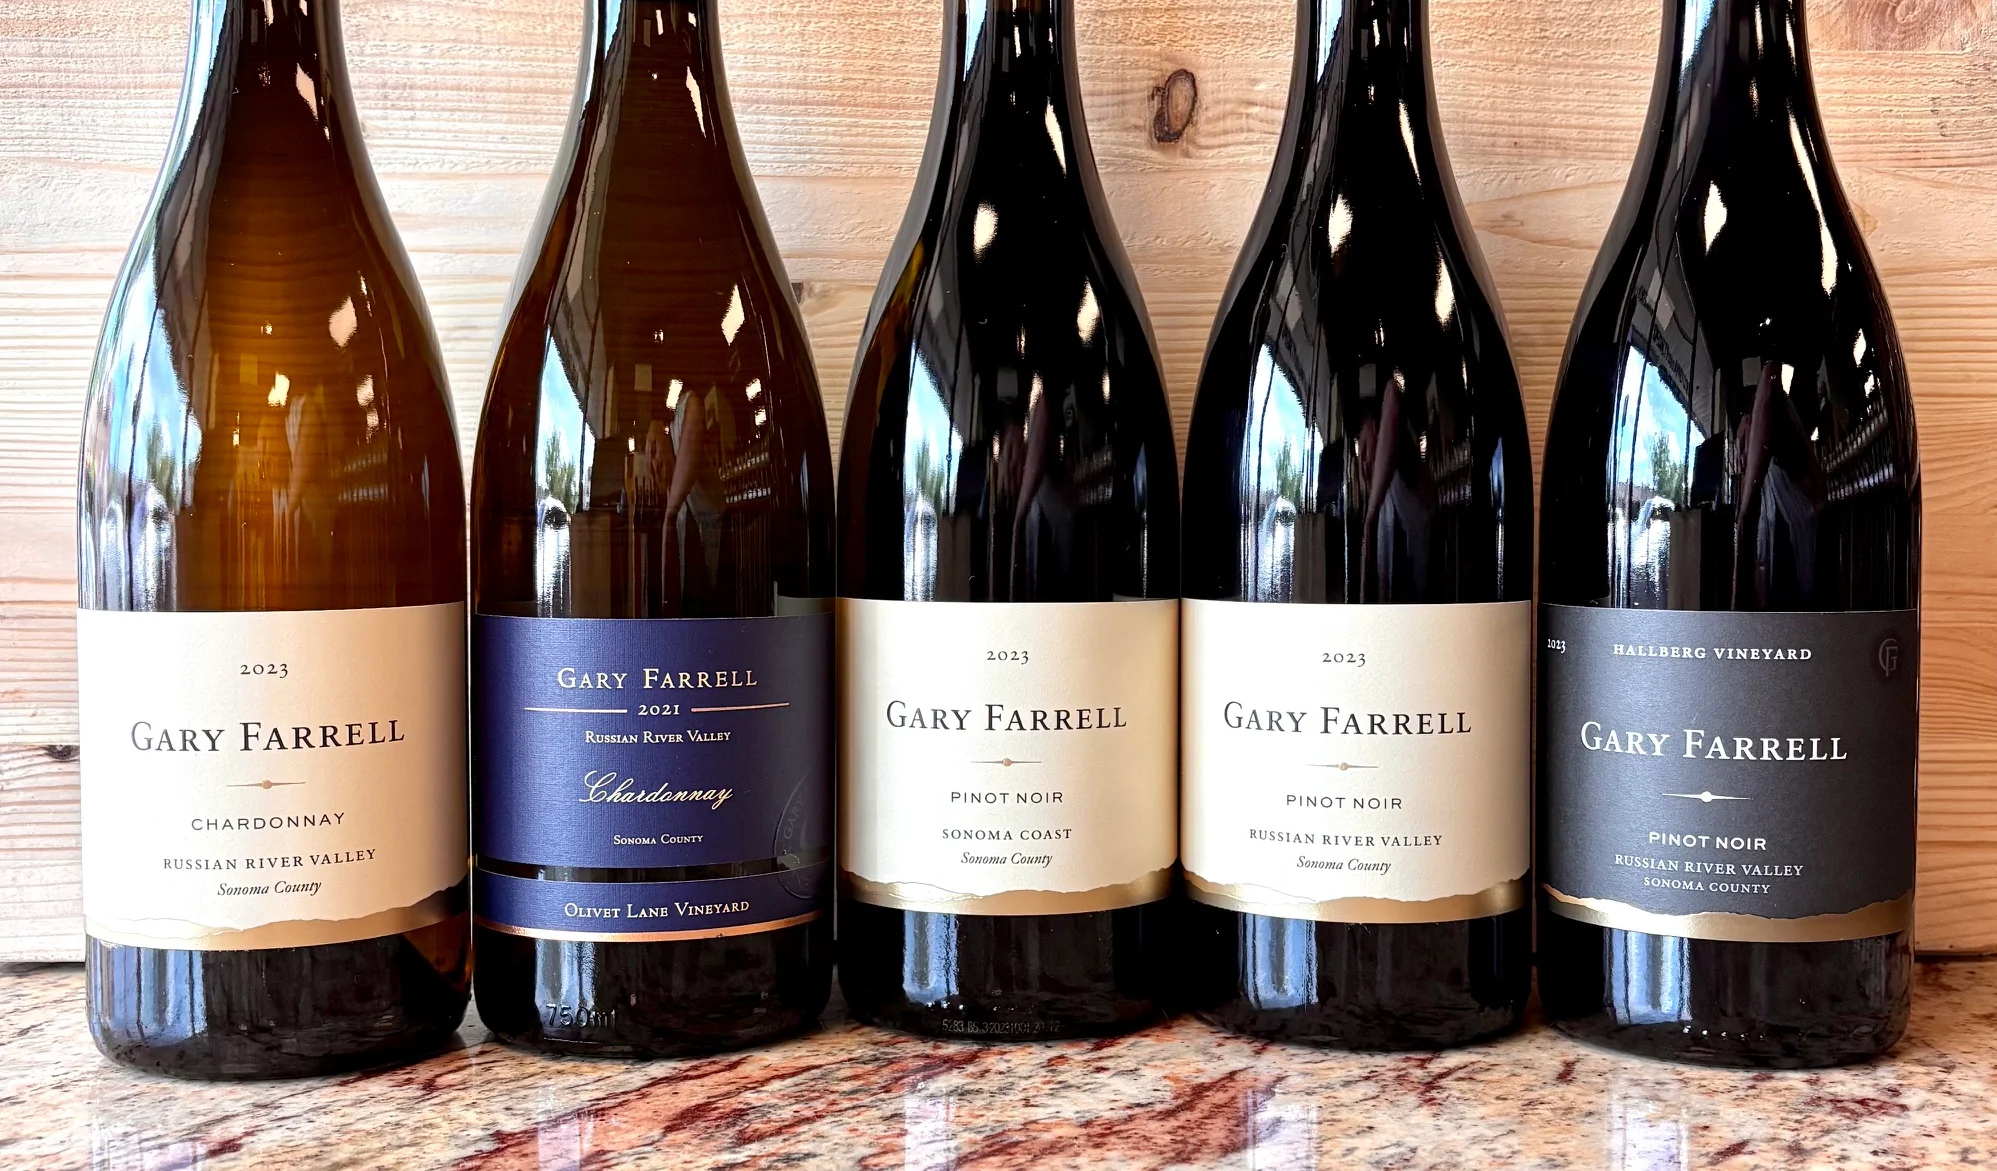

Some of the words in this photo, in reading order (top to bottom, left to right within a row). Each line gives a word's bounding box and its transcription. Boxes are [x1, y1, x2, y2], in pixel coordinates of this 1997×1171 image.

[1548, 639, 1565, 653] 2023
[1613, 644, 1706, 658] HALLBERG
[1714, 648, 1811, 659] VINEYARD
[987, 651, 1028, 665] 2023
[1323, 653, 1365, 667] 2023
[241, 664, 288, 678] 2023
[557, 668, 627, 689] GARY
[643, 669, 757, 688] FARRELL
[638, 705, 679, 715] 2021
[887, 700, 971, 730] GARY
[985, 704, 1126, 730] FARRELL
[1224, 701, 1307, 732] GARY
[1320, 707, 1471, 735] FARRELL
[132, 722, 225, 751] GARY
[240, 720, 404, 751] FARRELL
[586, 731, 638, 743] RUSSIAN
[643, 731, 683, 743] RIVER
[687, 730, 730, 741] VALLEY
[1581, 721, 1670, 756] GARY
[1683, 730, 1847, 760] FARRELL
[579, 771, 733, 810] Chardonnay
[952, 792, 1009, 803] PINOT
[1017, 792, 1062, 803] NOIR
[1287, 795, 1345, 808] PINOT
[1354, 798, 1401, 809] NOIR
[192, 813, 344, 830] CHARDONNAY
[614, 835, 656, 844] SONOMA
[661, 834, 703, 843] COUNTY
[943, 829, 1012, 840] SONOMA
[1020, 829, 1072, 840] COAST
[1250, 829, 1314, 844] RUSSIAN
[1323, 835, 1374, 846] RIVER
[1381, 836, 1442, 846] VALLEY
[1649, 832, 1710, 847] PINOT
[1716, 837, 1766, 850] NOIR
[164, 859, 236, 869] RUSSIAN
[246, 856, 303, 868] RIVER
[310, 849, 375, 865] VALLEY
[961, 852, 1007, 864] Sonoma
[1011, 853, 1052, 868] County
[1297, 856, 1343, 869] Sonoma
[1348, 859, 1391, 875] County
[1615, 854, 1678, 871] RUSSIAN
[1684, 862, 1736, 874] RIVER
[1741, 865, 1803, 875] VALLEY
[218, 884, 269, 895] Sonoma
[275, 881, 321, 896] County
[1644, 877, 1704, 890] SONOMA
[1709, 883, 1770, 893] COUNTY
[565, 903, 620, 918] OLIVET
[627, 904, 668, 918] LANE
[674, 902, 749, 916] VINEYARD
